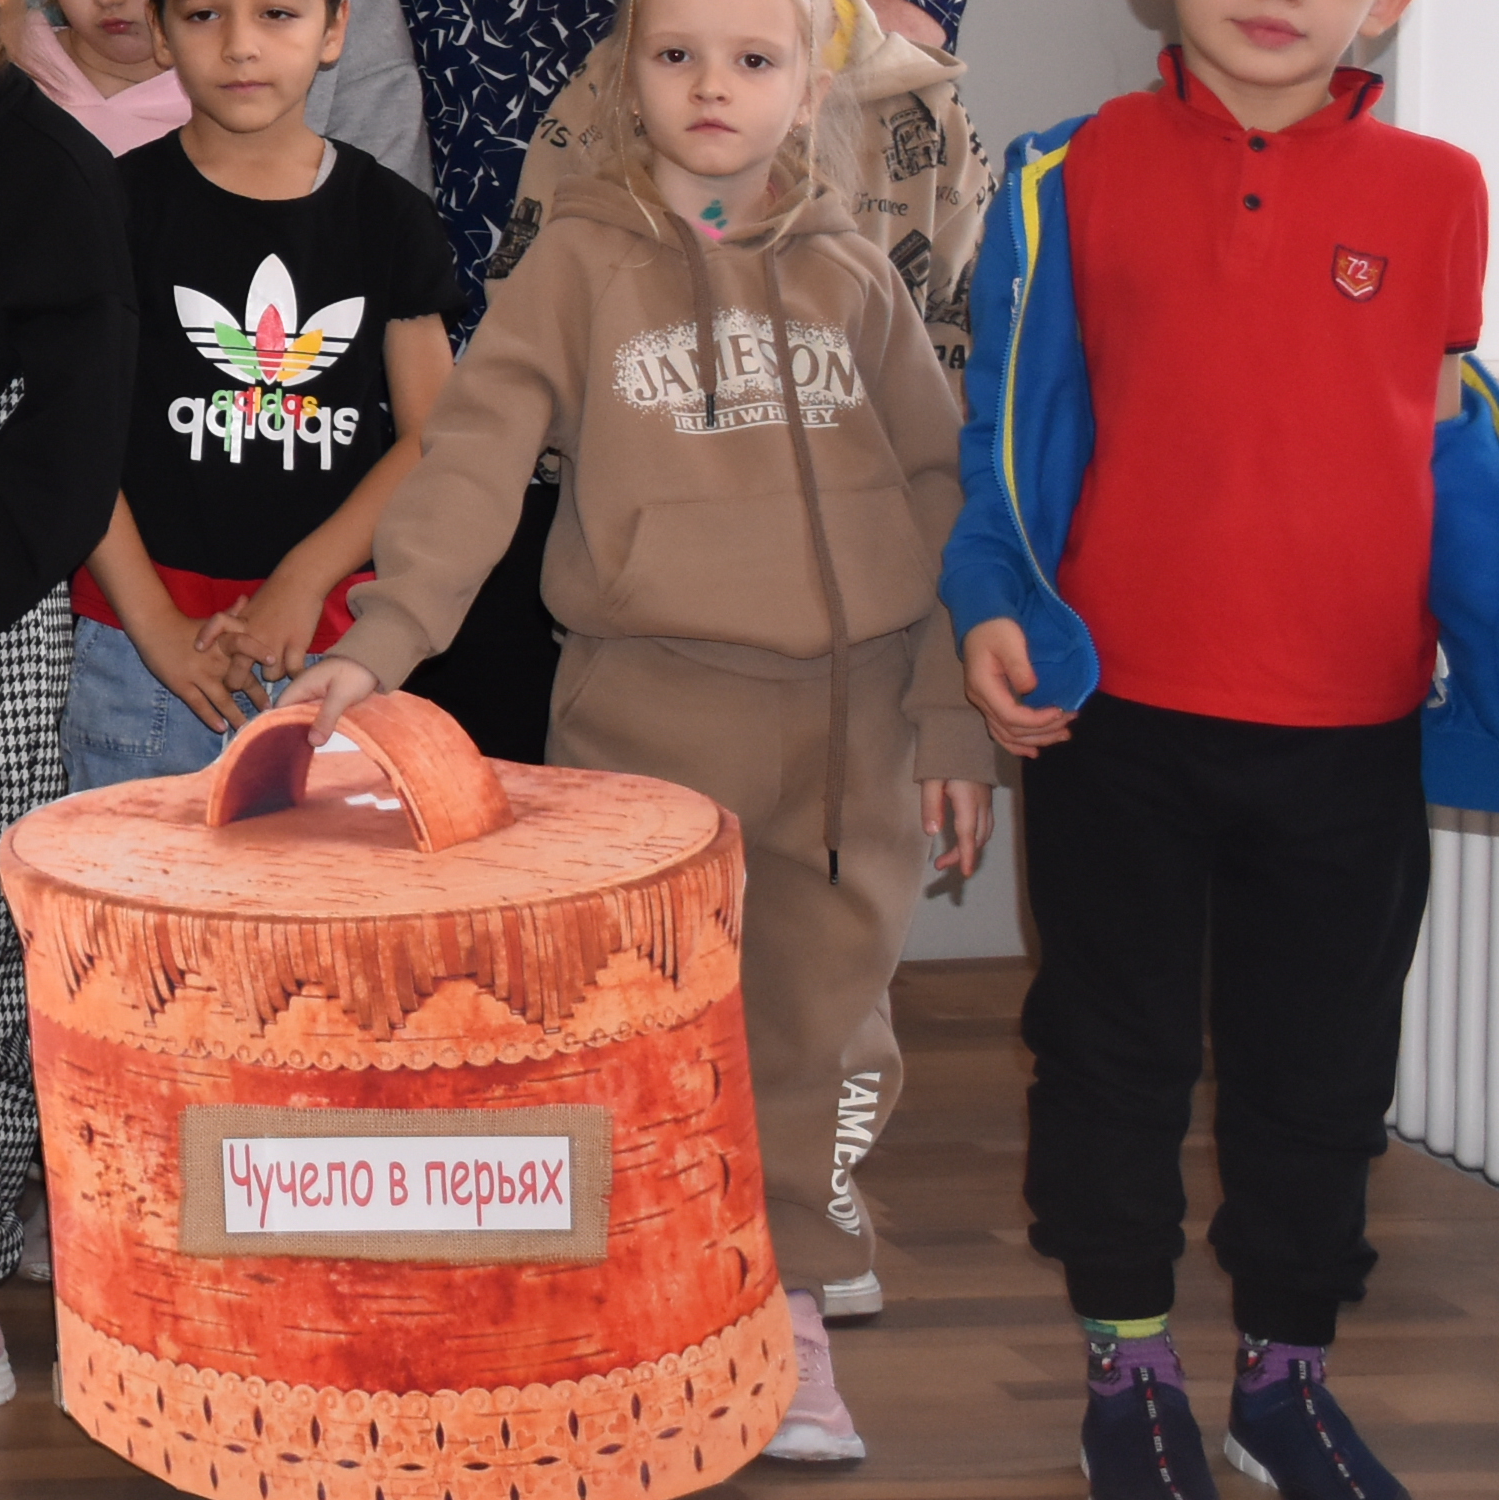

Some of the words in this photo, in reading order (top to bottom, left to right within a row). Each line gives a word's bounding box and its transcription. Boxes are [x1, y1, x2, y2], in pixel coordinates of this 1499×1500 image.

[1347, 256, 1368, 280] 72
[675, 411, 736, 431] IRIH
[229, 1143, 374, 1228] Чучело
[389, 1160, 409, 1206] в
[424, 1159, 563, 1227] перьях
